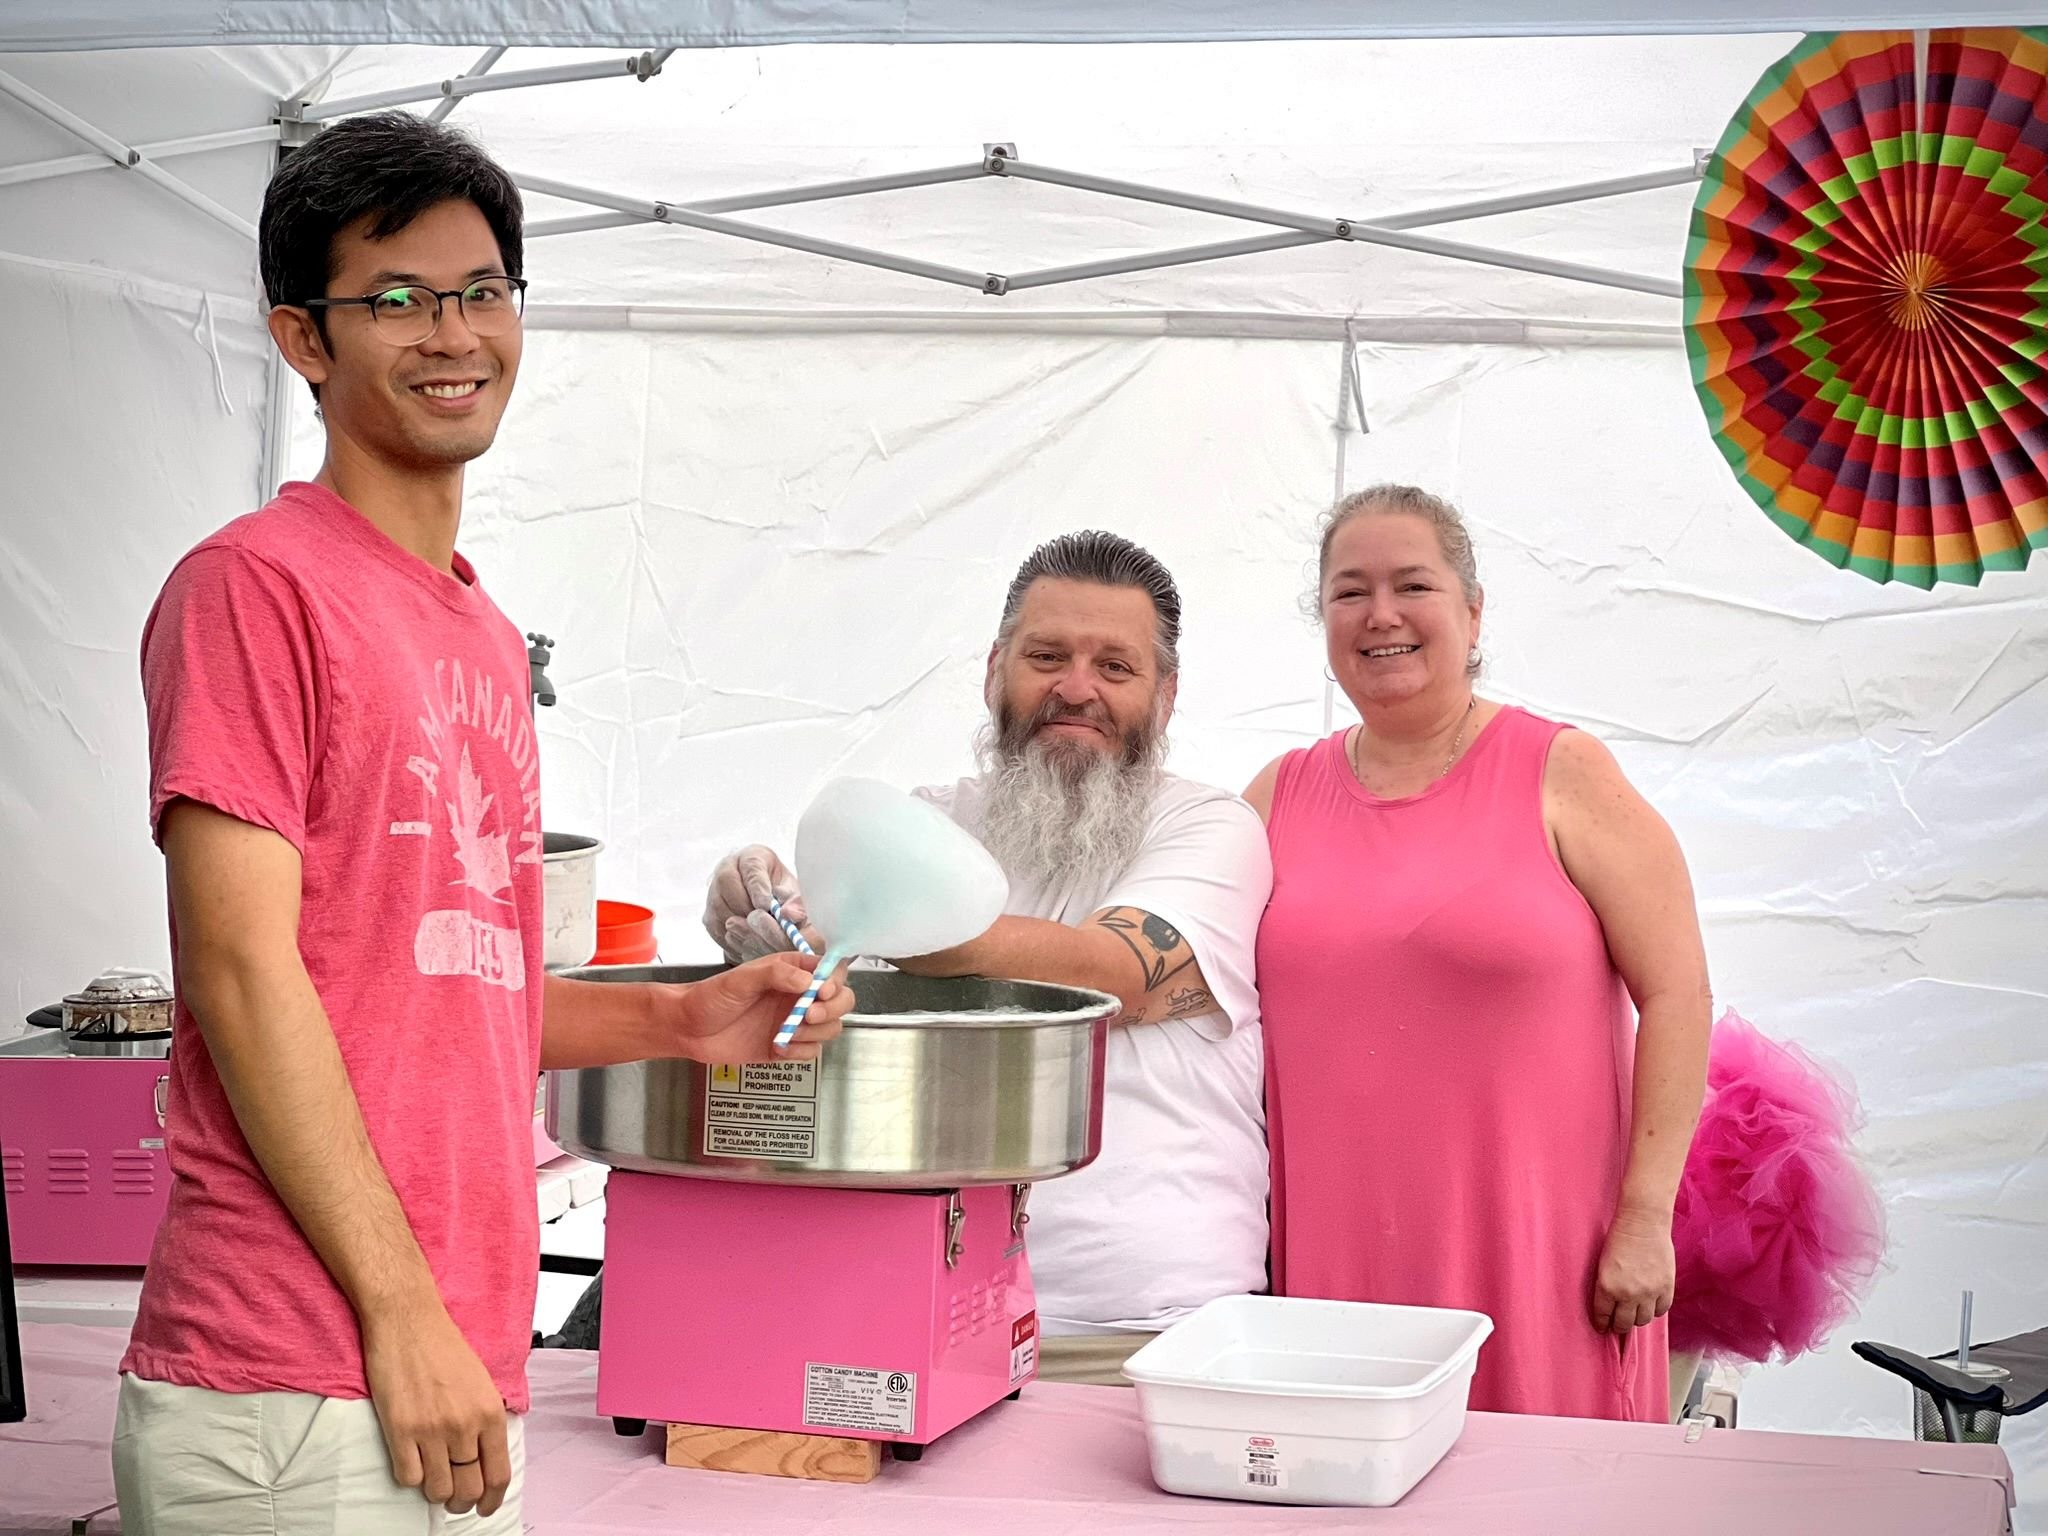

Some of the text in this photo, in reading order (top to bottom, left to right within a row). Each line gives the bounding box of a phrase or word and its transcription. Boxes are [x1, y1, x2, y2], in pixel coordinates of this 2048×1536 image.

[389, 657, 544, 865] I AM CANADIAN
[784, 1062, 794, 1071] OF
[796, 1064, 812, 1072] THE
[745, 1071, 802, 1082] FLOSS HEAD IS
[744, 1082, 791, 1092] PROHIBITED
[710, 1100, 740, 1108] CAUTION!
[714, 1128, 742, 1137] REMOVAL
[768, 1132, 790, 1140] FLOSS
[728, 1138, 760, 1147] CLEANING
[769, 1141, 809, 1150] PROHIBITED
[854, 1370, 878, 1378] MACHINE
[889, 1375, 906, 1392] ETL
